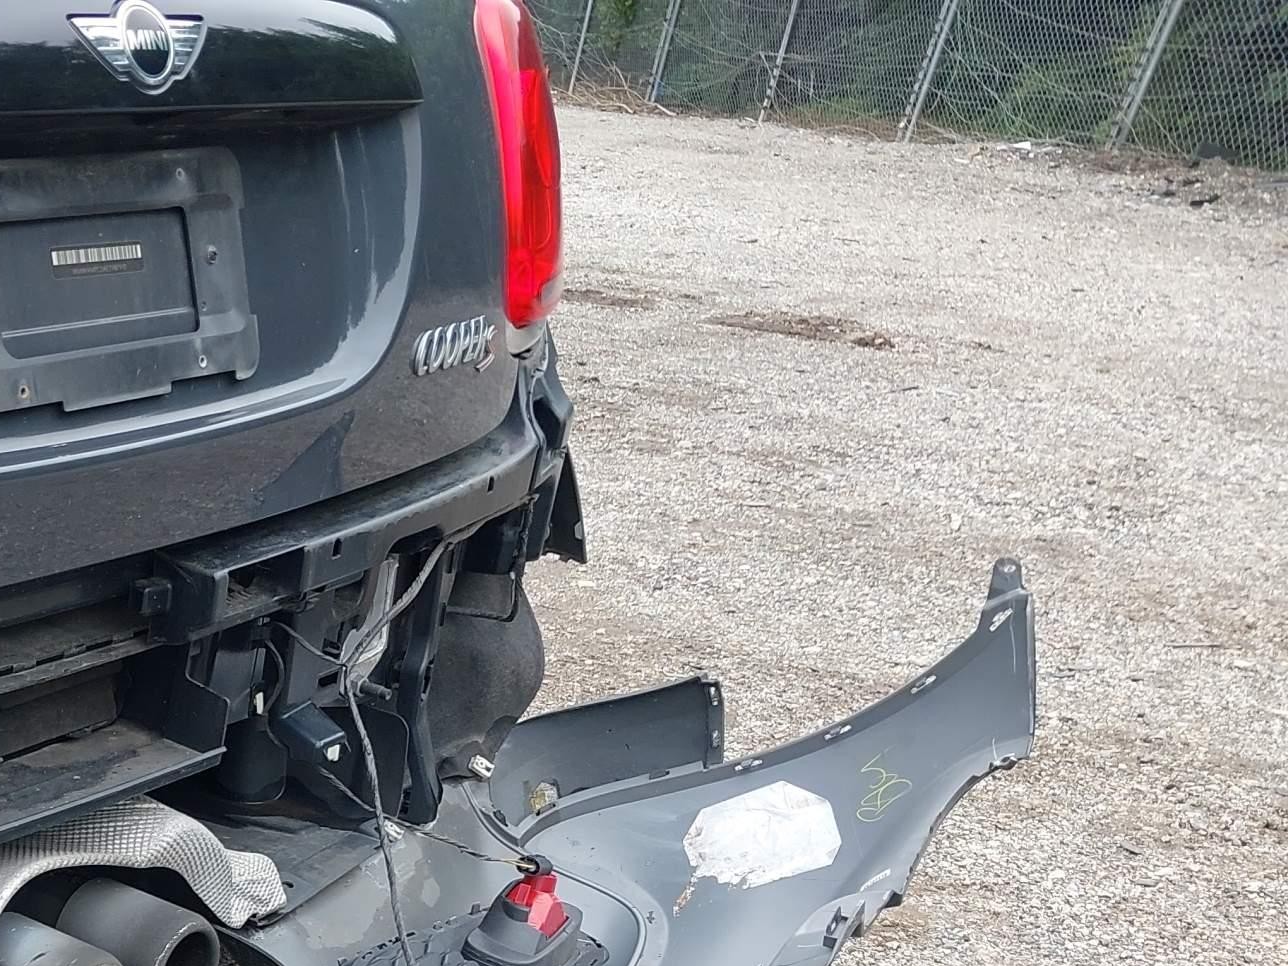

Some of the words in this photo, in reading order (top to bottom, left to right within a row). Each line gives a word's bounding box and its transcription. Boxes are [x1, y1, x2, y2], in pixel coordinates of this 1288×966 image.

[126, 29, 169, 51] MINI
[412, 315, 488, 377] COOPER
[473, 324, 499, 373] S
